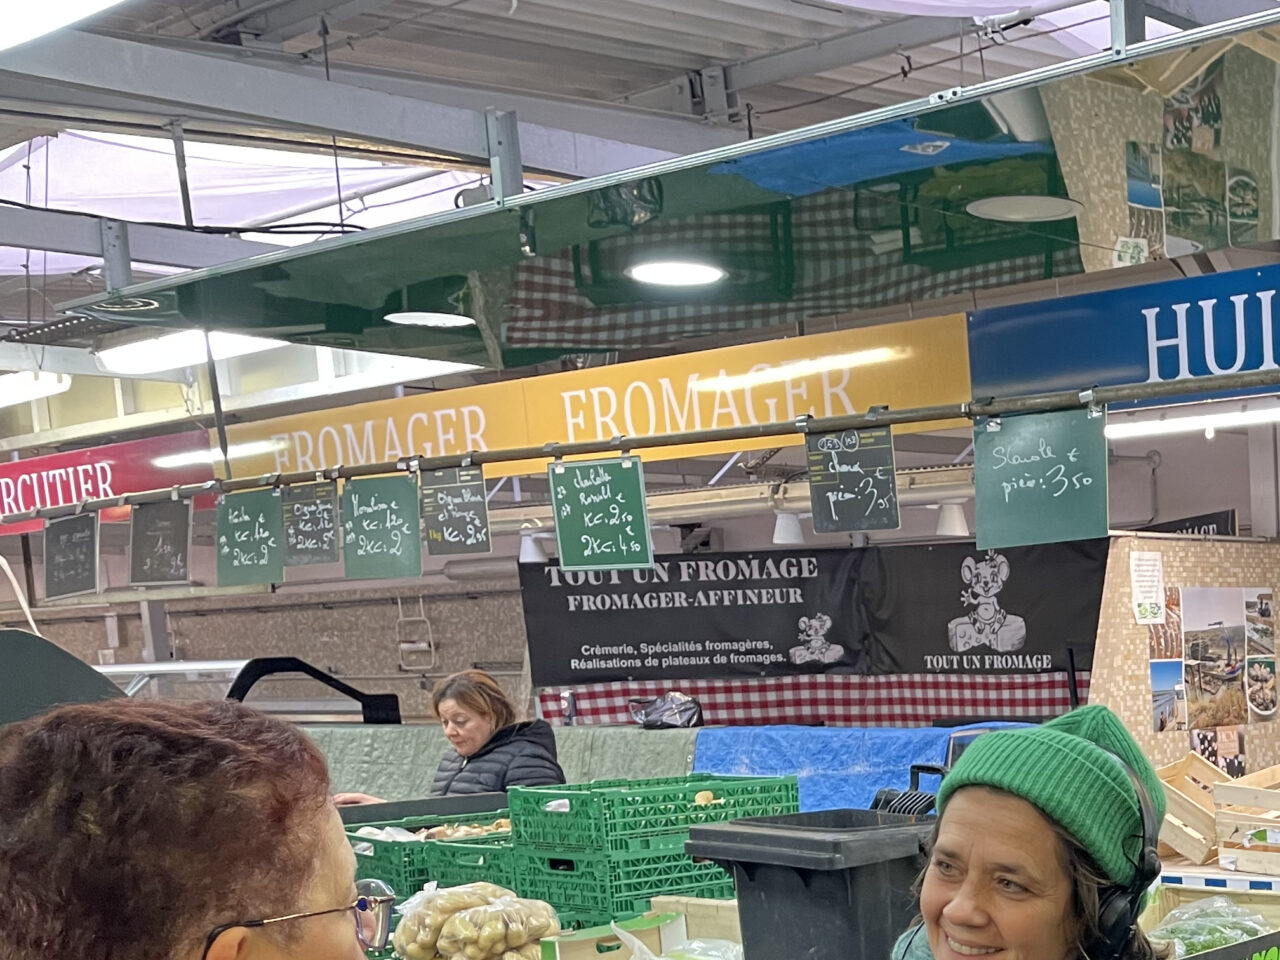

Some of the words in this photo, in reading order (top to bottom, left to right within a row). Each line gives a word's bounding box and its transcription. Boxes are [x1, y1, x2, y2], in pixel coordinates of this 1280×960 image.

[560, 363, 857, 443] FROMAGER
[270, 405, 489, 473] FROMAGER
[544, 565, 623, 587] TOUT
[632, 562, 670, 584] UN
[678, 557, 819, 583] FROMAGE
[566, 587, 804, 611] FROMAGER-AFFINEUR
[581, 643, 637, 656] Crèmerie,
[640, 639, 702, 655] Spécialités
[705, 638, 774, 653] fromagères,
[570, 656, 642, 670] Réalisations
[644, 656, 659, 668] de
[662, 654, 711, 668] plateaux
[713, 653, 728, 665] de
[730, 651, 787, 666] fromages.
[924, 654, 961, 669] TOUT
[963, 654, 981, 669] UN
[984, 654, 1052, 670] FROMAGE
